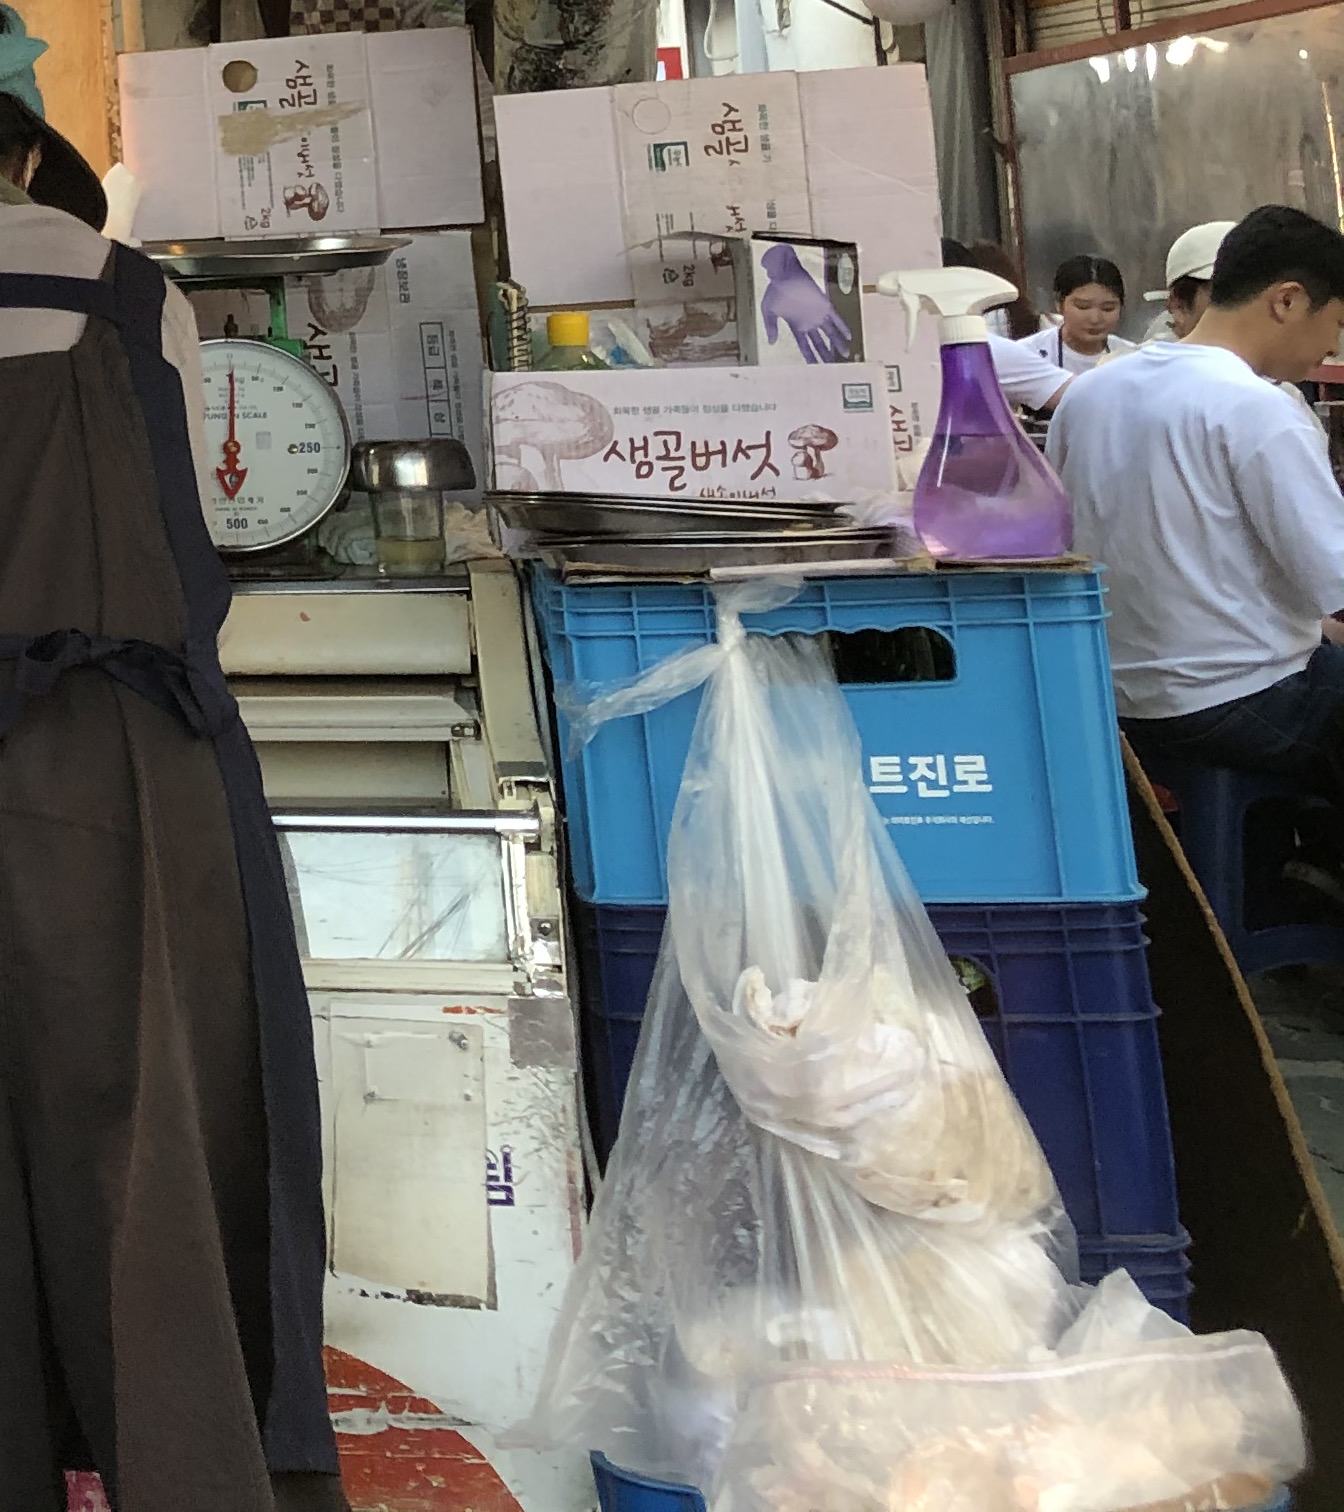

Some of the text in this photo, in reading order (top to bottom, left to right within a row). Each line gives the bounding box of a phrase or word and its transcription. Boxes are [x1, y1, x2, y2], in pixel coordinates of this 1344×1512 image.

[682, 264, 696, 287] 2kg
[298, 442, 321, 454] 250
[226, 518, 249, 530] 500
[869, 753, 993, 798] 트진로
